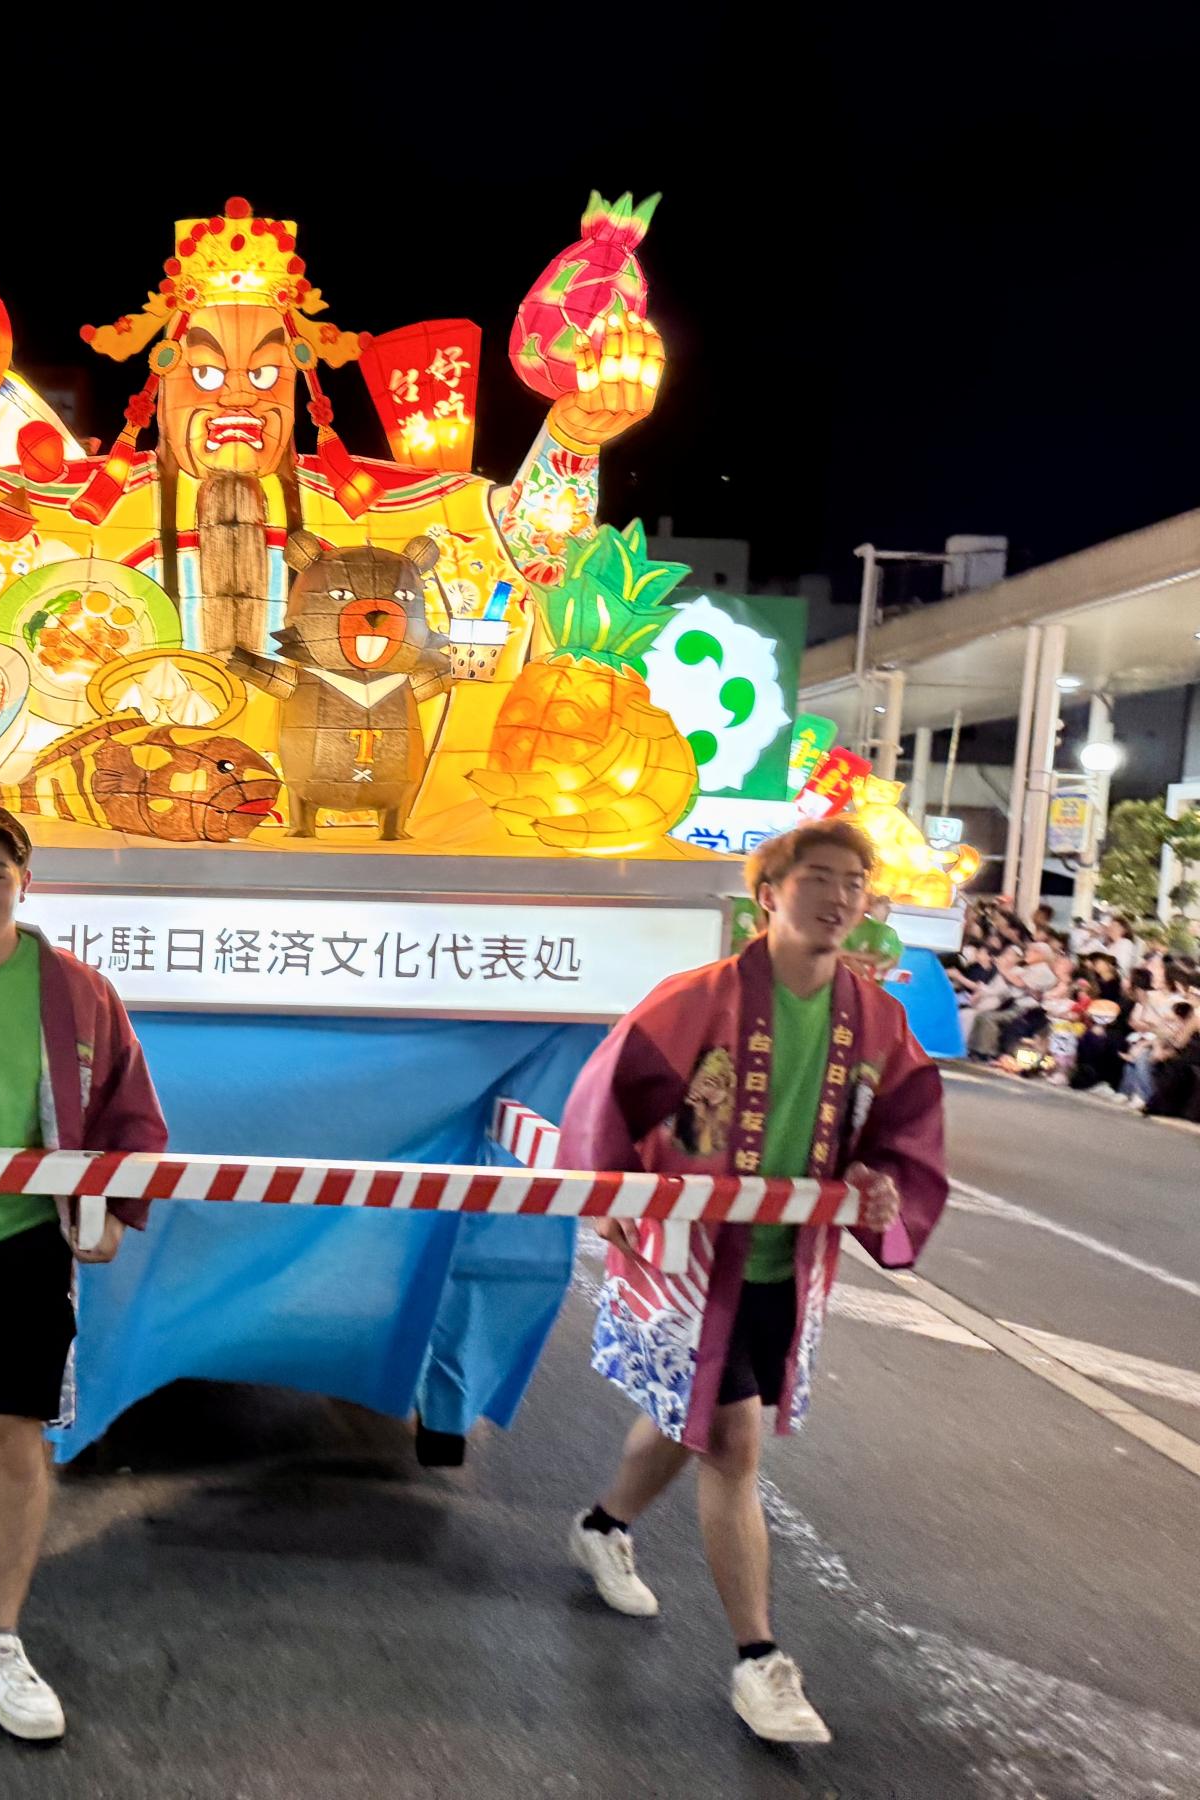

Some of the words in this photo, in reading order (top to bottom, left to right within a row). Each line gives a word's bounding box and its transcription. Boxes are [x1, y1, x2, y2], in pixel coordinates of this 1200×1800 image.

[57, 923, 582, 982] 北駐日経済文化代表処
